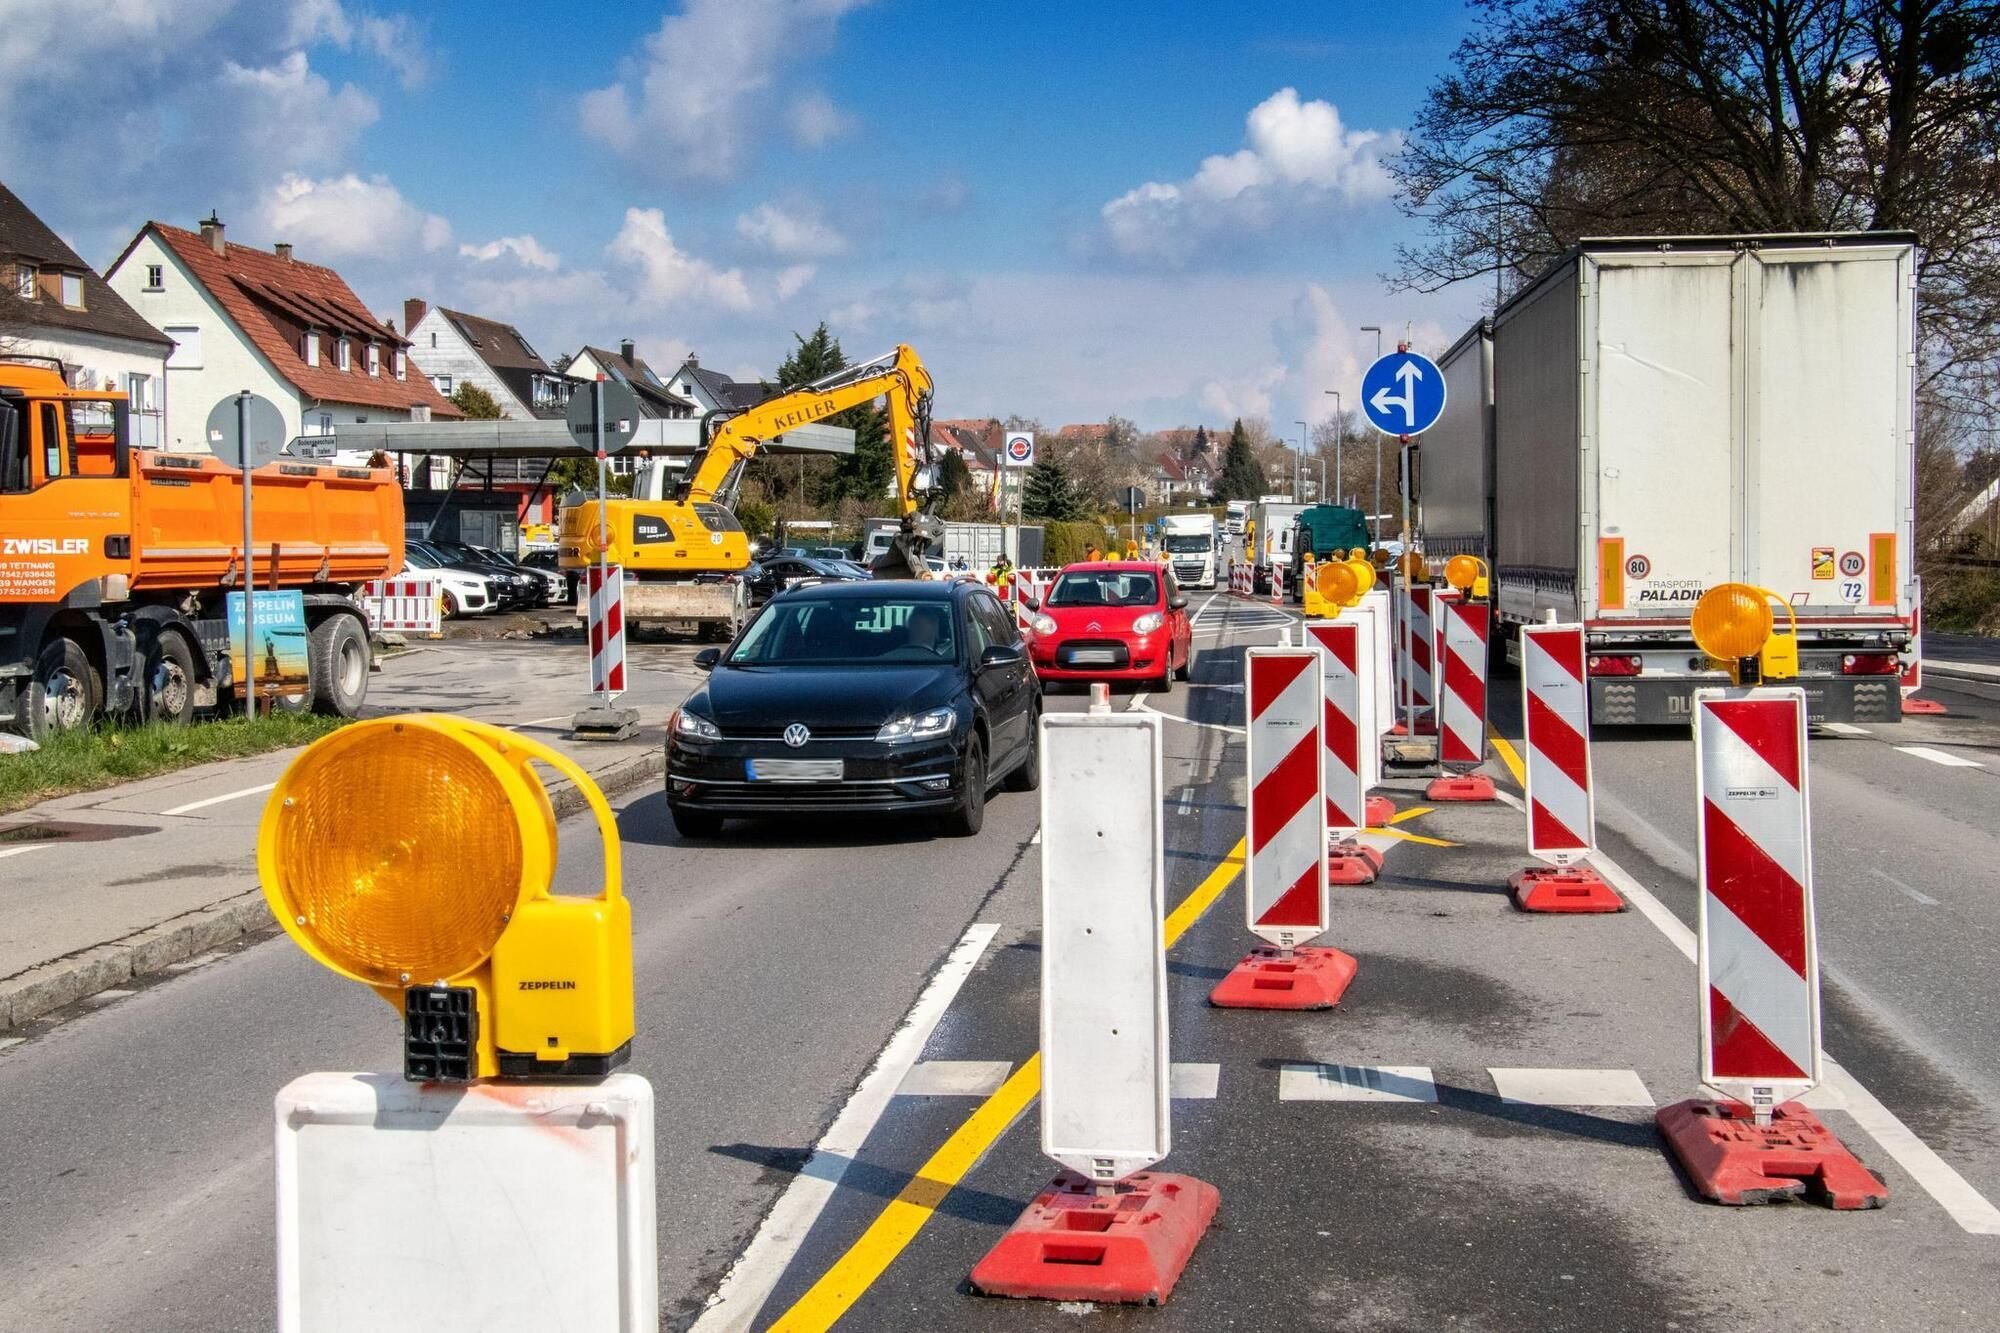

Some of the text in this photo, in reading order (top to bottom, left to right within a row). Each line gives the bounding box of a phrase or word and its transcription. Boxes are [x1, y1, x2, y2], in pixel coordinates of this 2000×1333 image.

[774, 399, 836, 430] KELLER
[3, 538, 89, 555] ZWISLER
[9, 561, 56, 570] TETTNANG
[1630, 561, 1646, 574] 80
[1847, 559, 1859, 570] 70
[13, 579, 56, 587] WANGEN
[1648, 580, 1703, 589] TRASPORTI
[1843, 583, 1862, 598] 72
[519, 980, 576, 991] ZEPPELIN
